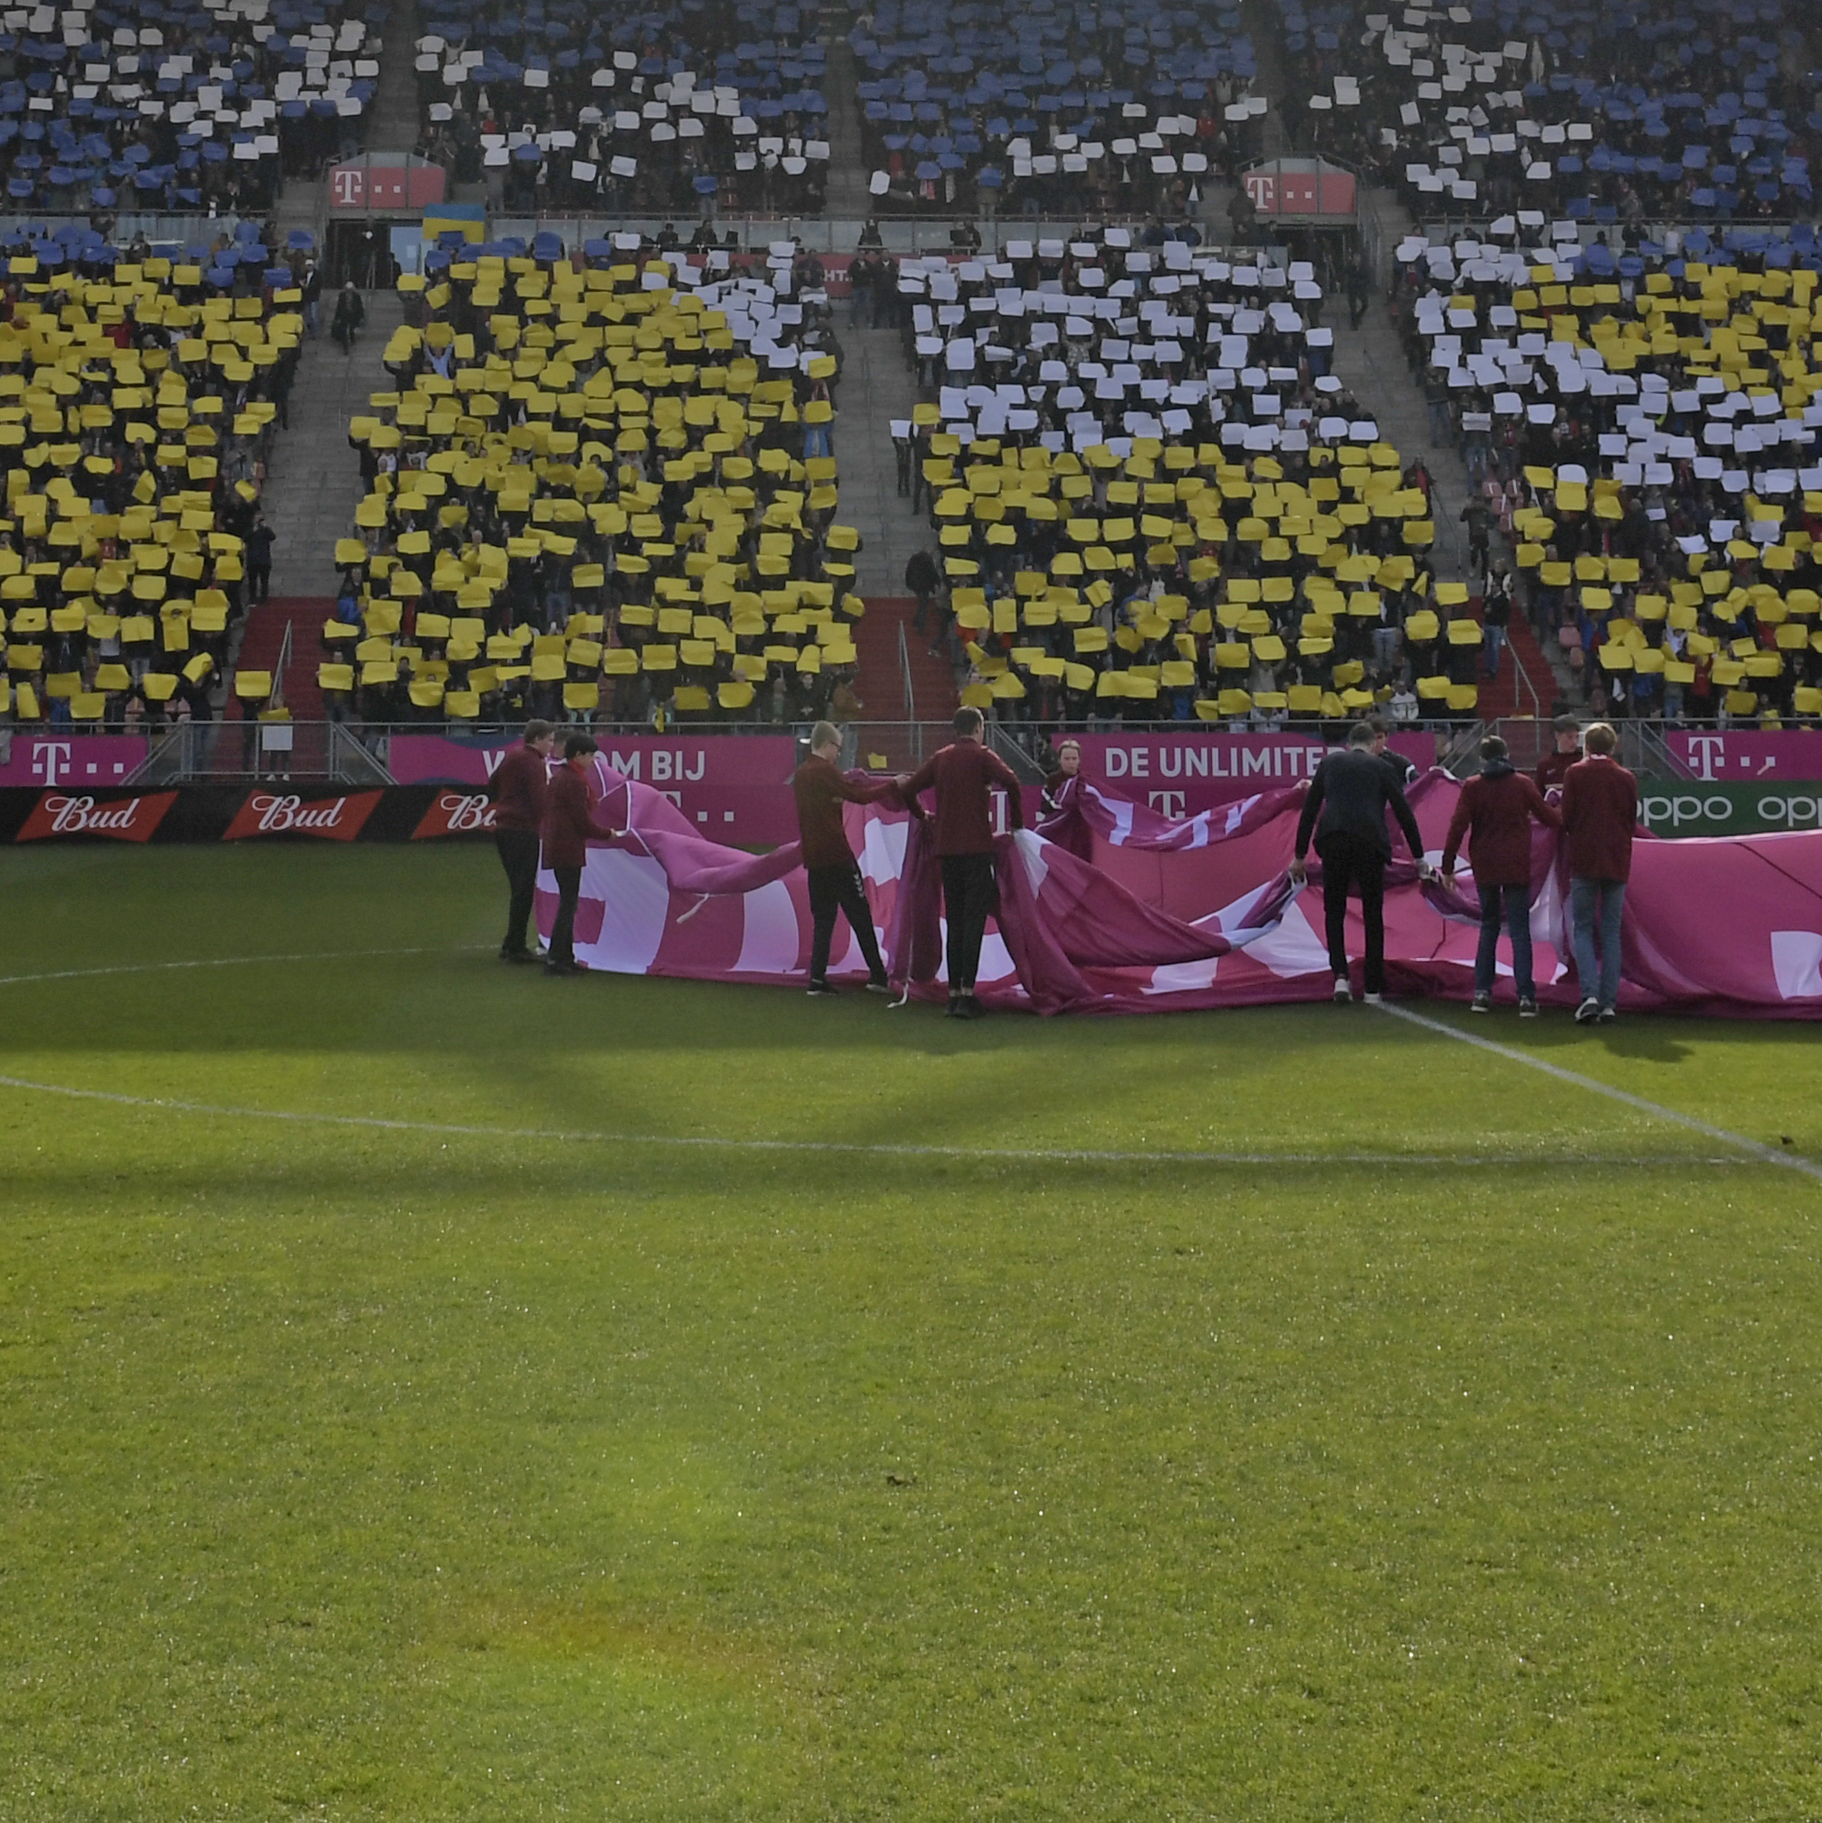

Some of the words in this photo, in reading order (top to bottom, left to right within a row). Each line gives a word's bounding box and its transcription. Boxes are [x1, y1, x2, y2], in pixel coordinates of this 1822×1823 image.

[652, 750, 706, 781] BIJ
[1105, 747, 1150, 778] DE
[1159, 745, 1347, 777] UNLIMITE
[45, 795, 141, 832] Bud
[252, 794, 346, 831] Bud
[440, 793, 497, 830] Bu
[1637, 795, 1733, 827] ppo
